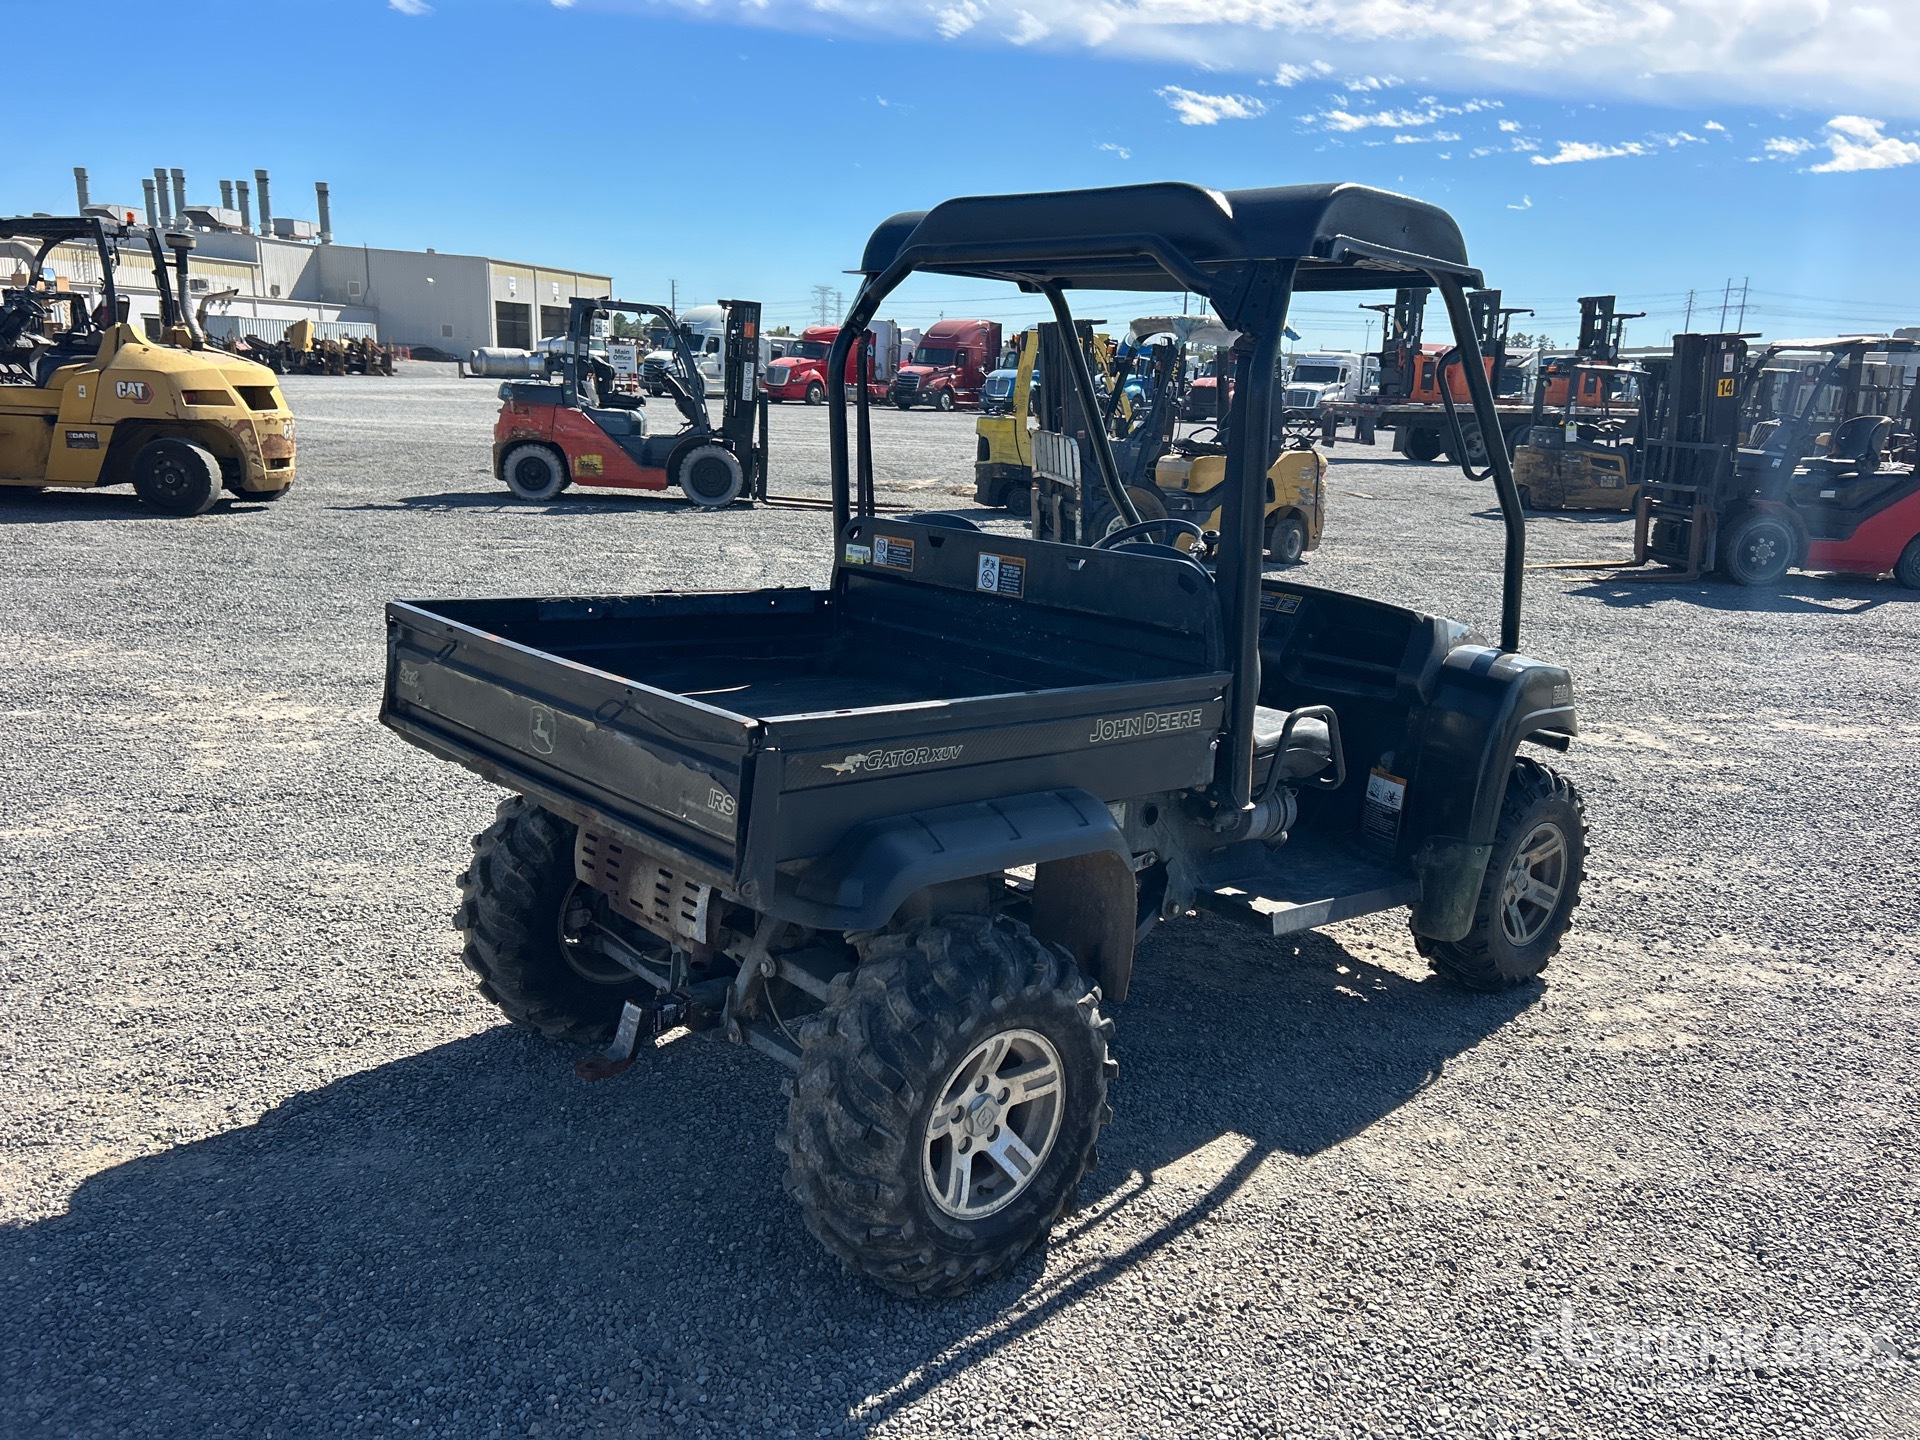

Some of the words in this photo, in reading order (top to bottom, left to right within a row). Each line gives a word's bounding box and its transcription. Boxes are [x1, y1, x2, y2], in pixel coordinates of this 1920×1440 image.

[116, 381, 144, 399] CAT
[1720, 379, 1733, 396] 14
[1600, 475, 1618, 487] CAT
[1089, 717, 1141, 743] JOHN
[1143, 708, 1202, 735] DEERE
[863, 747, 930, 771] GATOR
[928, 745, 963, 763] XUV
[707, 788, 736, 816] IRS
